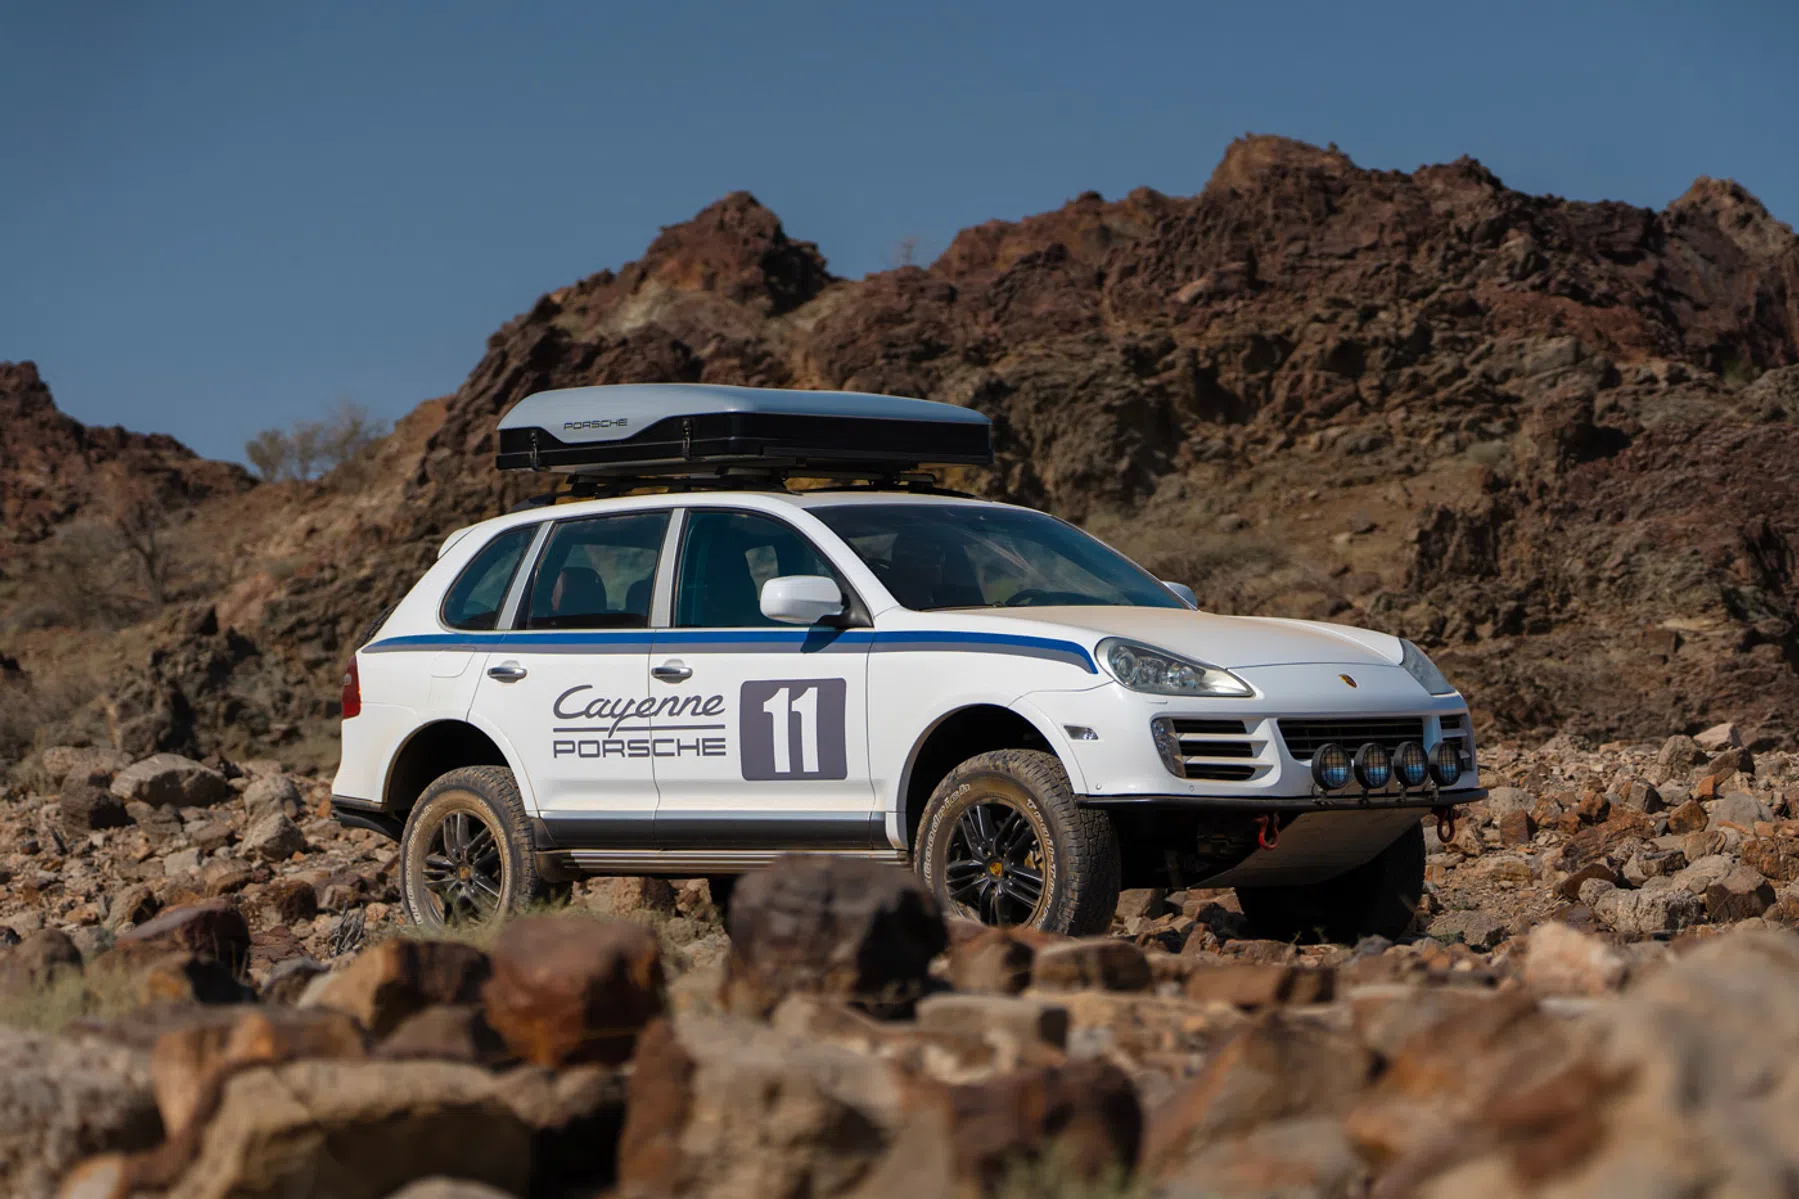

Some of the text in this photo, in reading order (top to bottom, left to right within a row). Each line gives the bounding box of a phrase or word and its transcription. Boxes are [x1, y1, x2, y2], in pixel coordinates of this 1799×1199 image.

[563, 418, 628, 430] PORSCHE
[553, 685, 725, 738] Cayenne
[553, 738, 726, 758] PORSCHE
[763, 687, 819, 773] 11
